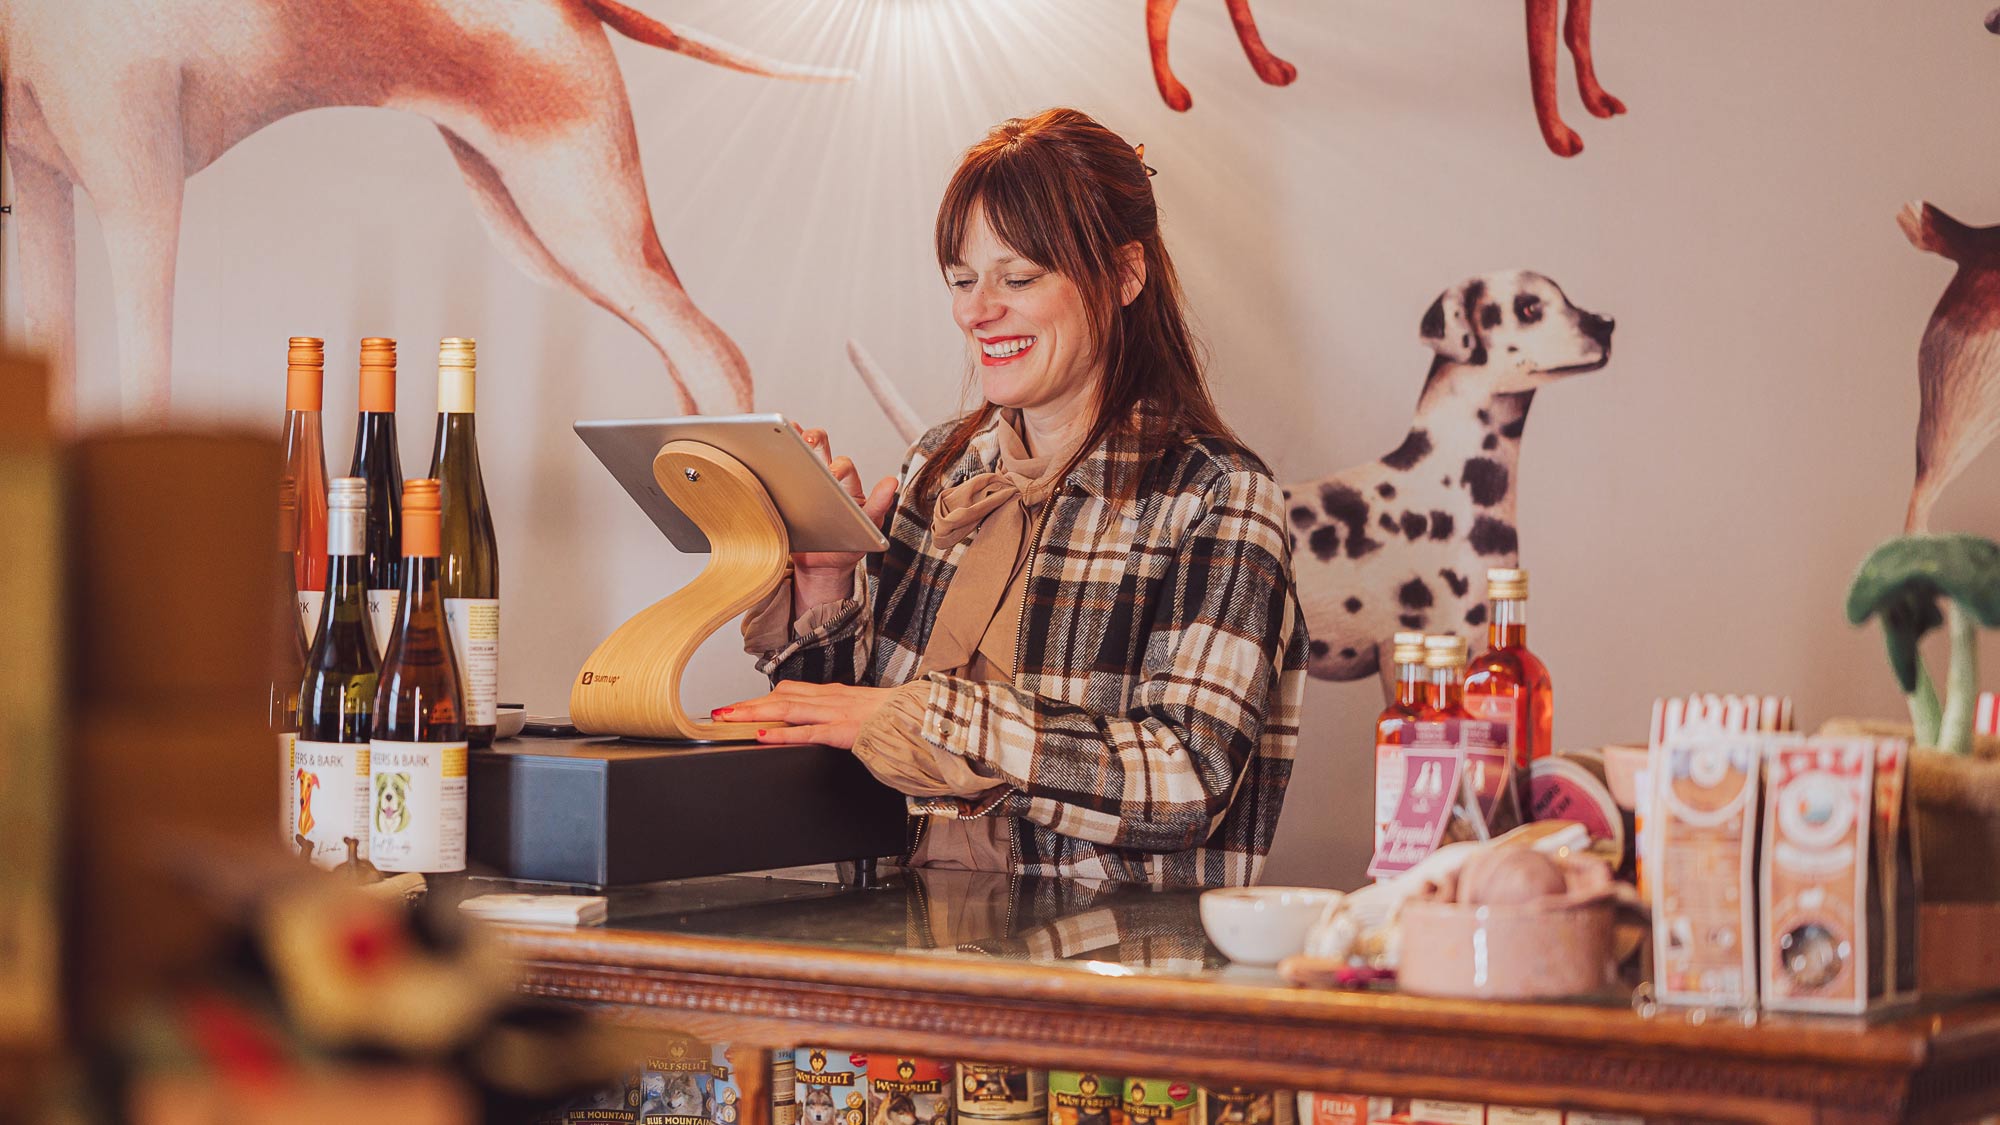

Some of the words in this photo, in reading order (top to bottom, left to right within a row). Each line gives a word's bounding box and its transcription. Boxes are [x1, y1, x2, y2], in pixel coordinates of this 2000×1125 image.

[317, 754, 344, 768] BARK
[402, 753, 430, 767] BARK
[648, 1058, 709, 1071] WOLFSBLUT
[796, 1071, 851, 1085] WOLFSBLUT
[569, 1111, 585, 1120] BLUE
[587, 1111, 635, 1121] MOUNTAIN
[646, 1116, 664, 1125] BLUE
